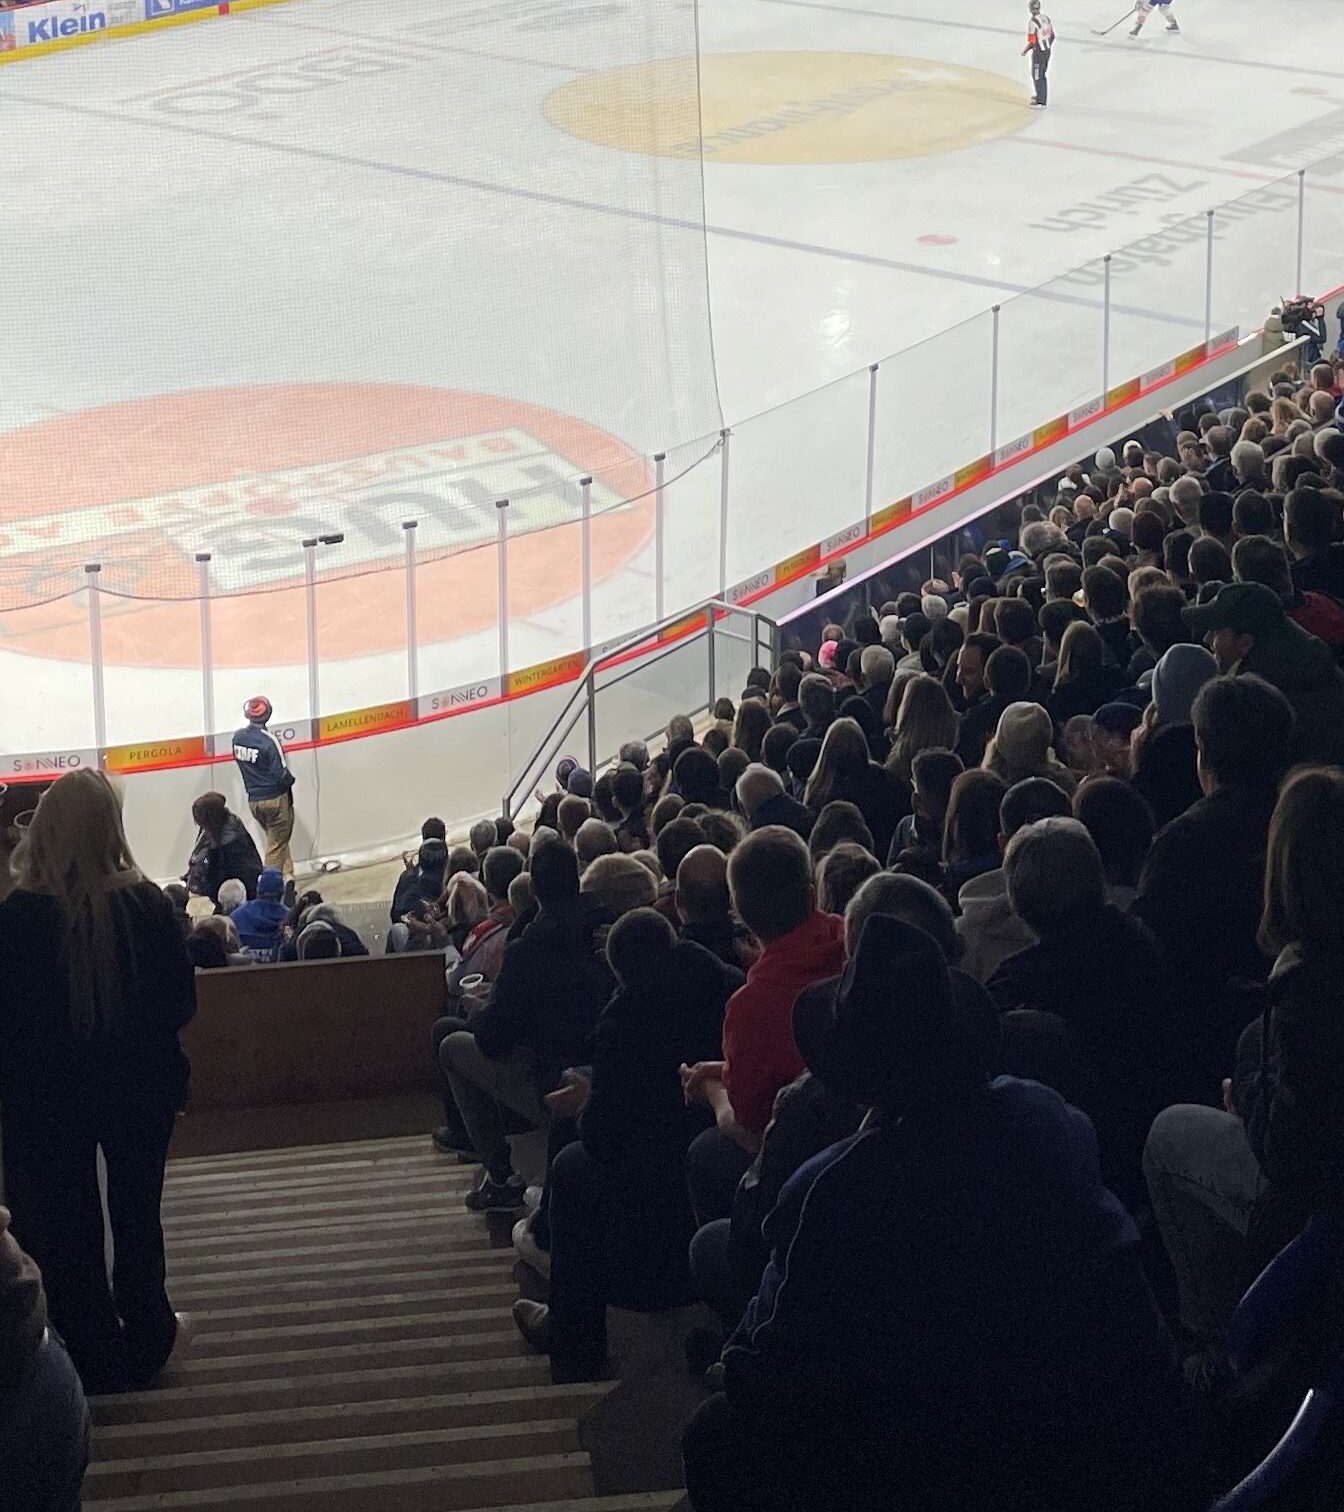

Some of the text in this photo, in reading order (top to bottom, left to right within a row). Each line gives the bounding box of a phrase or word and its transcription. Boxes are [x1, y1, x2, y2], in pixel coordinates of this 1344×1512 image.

[28, 10, 105, 43] Klein
[1026, 173, 1207, 233] Zürich
[1055, 189, 1296, 287] Flughafen
[202, 464, 593, 572] HUG
[513, 658, 579, 686] WINTERGARTEN
[327, 707, 404, 732] LAMELLENDACH
[129, 745, 182, 761] PERGOLA
